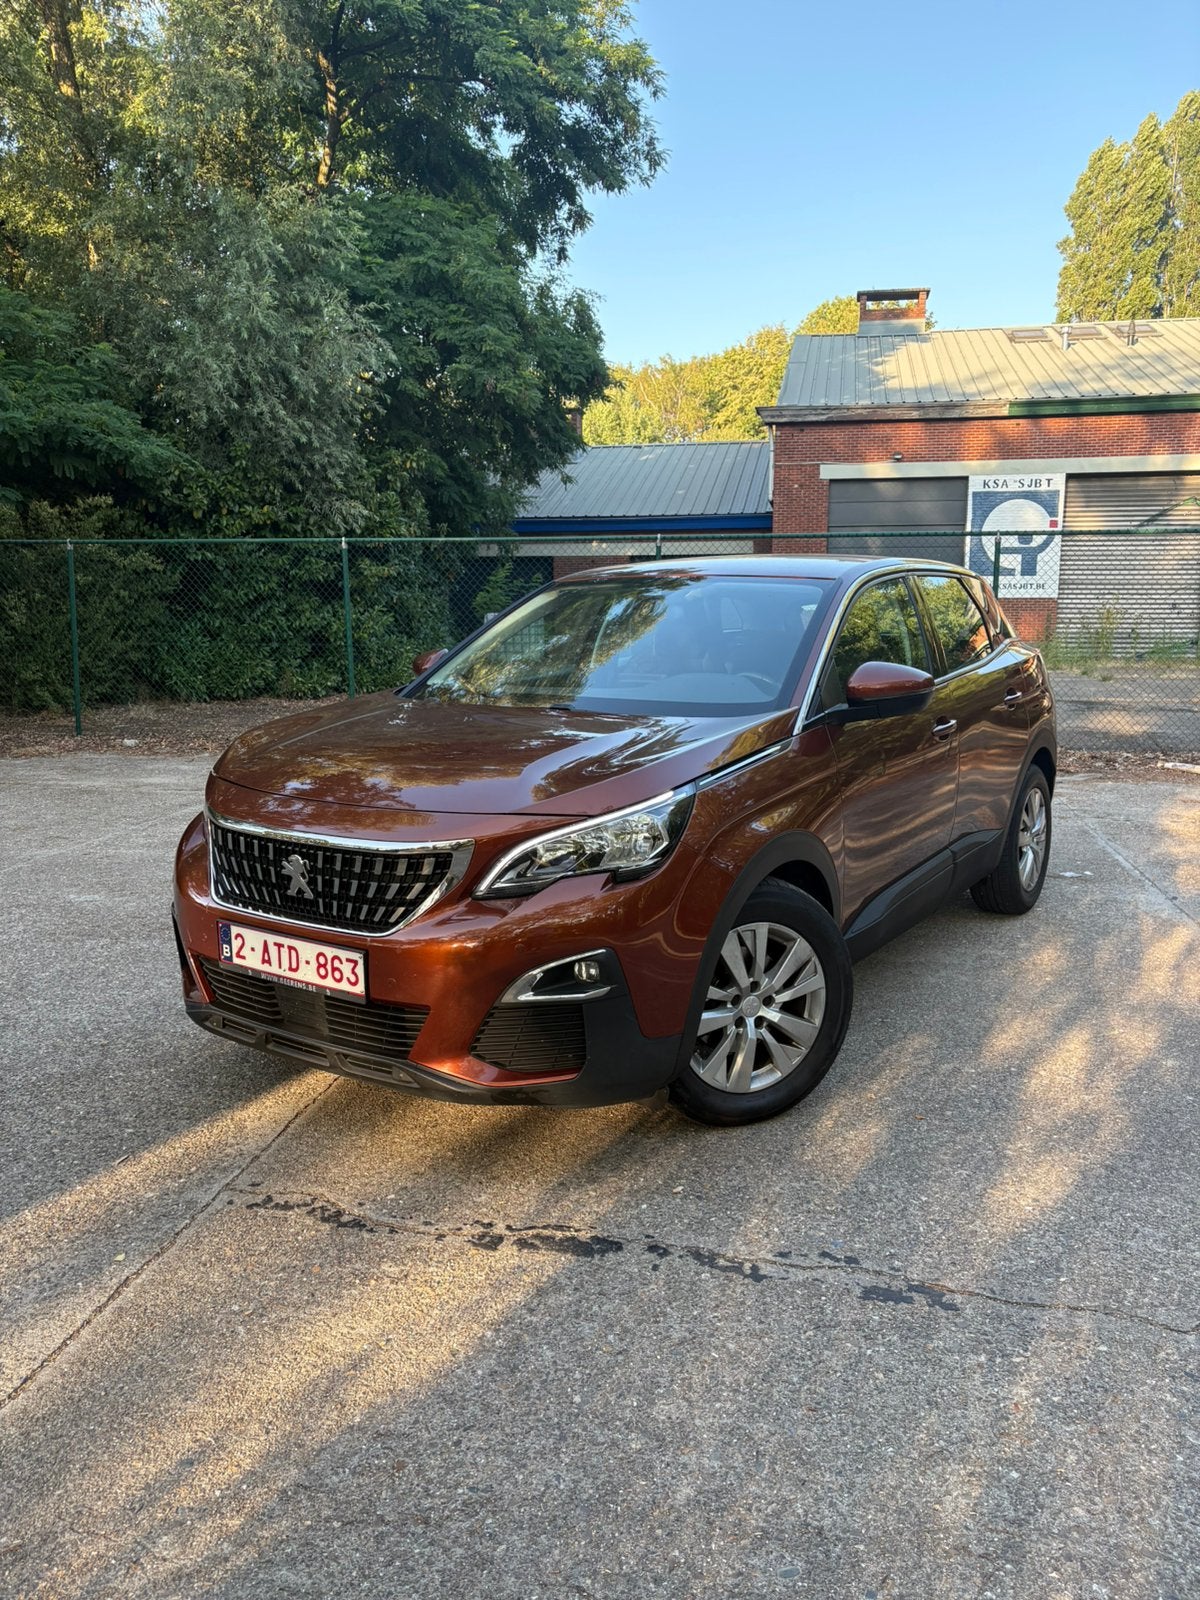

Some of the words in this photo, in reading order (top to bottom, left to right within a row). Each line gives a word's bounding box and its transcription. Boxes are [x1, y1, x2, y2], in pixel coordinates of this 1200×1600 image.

[983, 479, 1009, 489] KSA
[222, 944, 231, 957] B
[234, 932, 360, 987] 2-ATD-863
